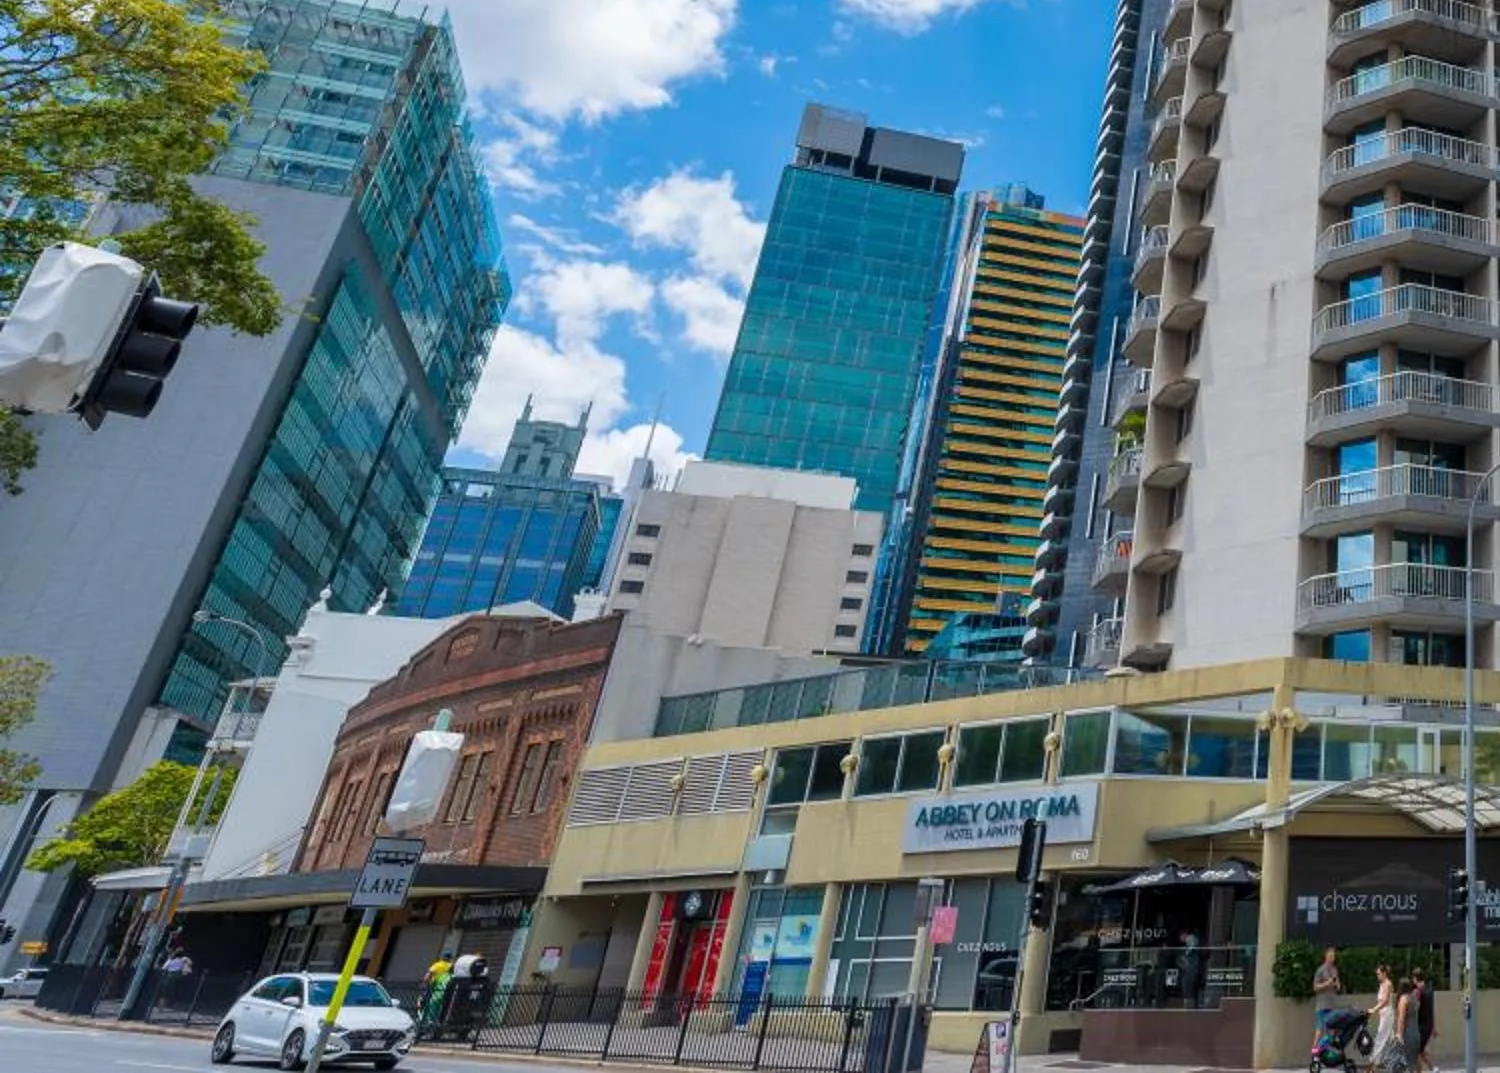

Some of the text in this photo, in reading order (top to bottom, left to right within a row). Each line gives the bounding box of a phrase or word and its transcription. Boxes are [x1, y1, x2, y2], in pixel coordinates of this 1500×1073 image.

[915, 802, 983, 828] ABBEY
[985, 799, 1015, 821] ON
[944, 828, 974, 842] HOTEL
[985, 824, 1024, 839] APARTM
[359, 877, 406, 894] LANE
[1321, 889, 1417, 912] chez nous
